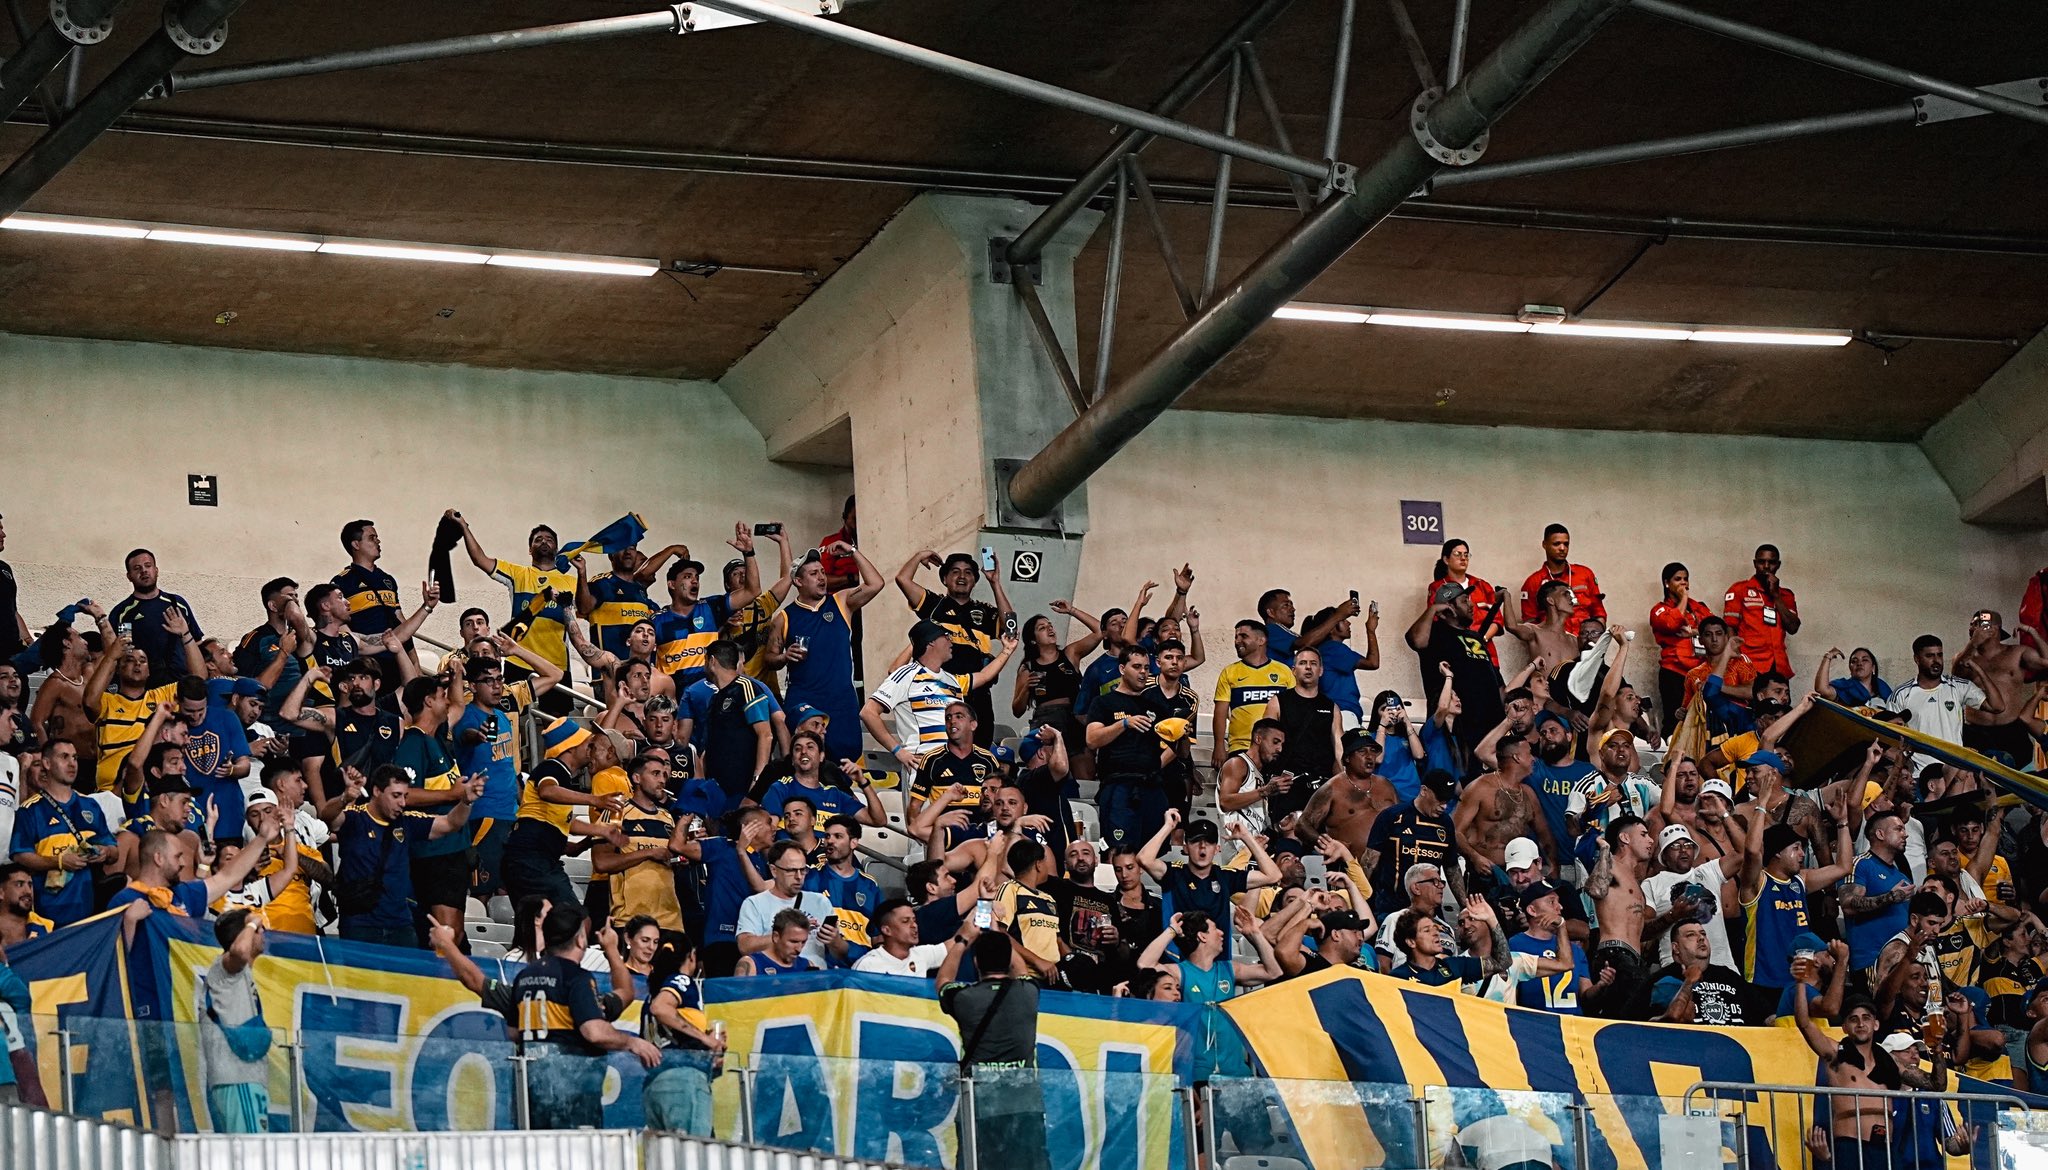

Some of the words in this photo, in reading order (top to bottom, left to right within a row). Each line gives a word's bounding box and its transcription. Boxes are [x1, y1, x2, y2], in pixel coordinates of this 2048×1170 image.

[1407, 514, 1439, 532] 302
[1243, 690, 1280, 702] PEPS
[190, 743, 217, 760] CABJ
[1543, 778, 1577, 796] CAB
[1401, 844, 1443, 860] betsson
[1796, 911, 1808, 927] 2
[1541, 970, 1578, 1008] 12
[1699, 981, 1737, 995] JUNIORS
